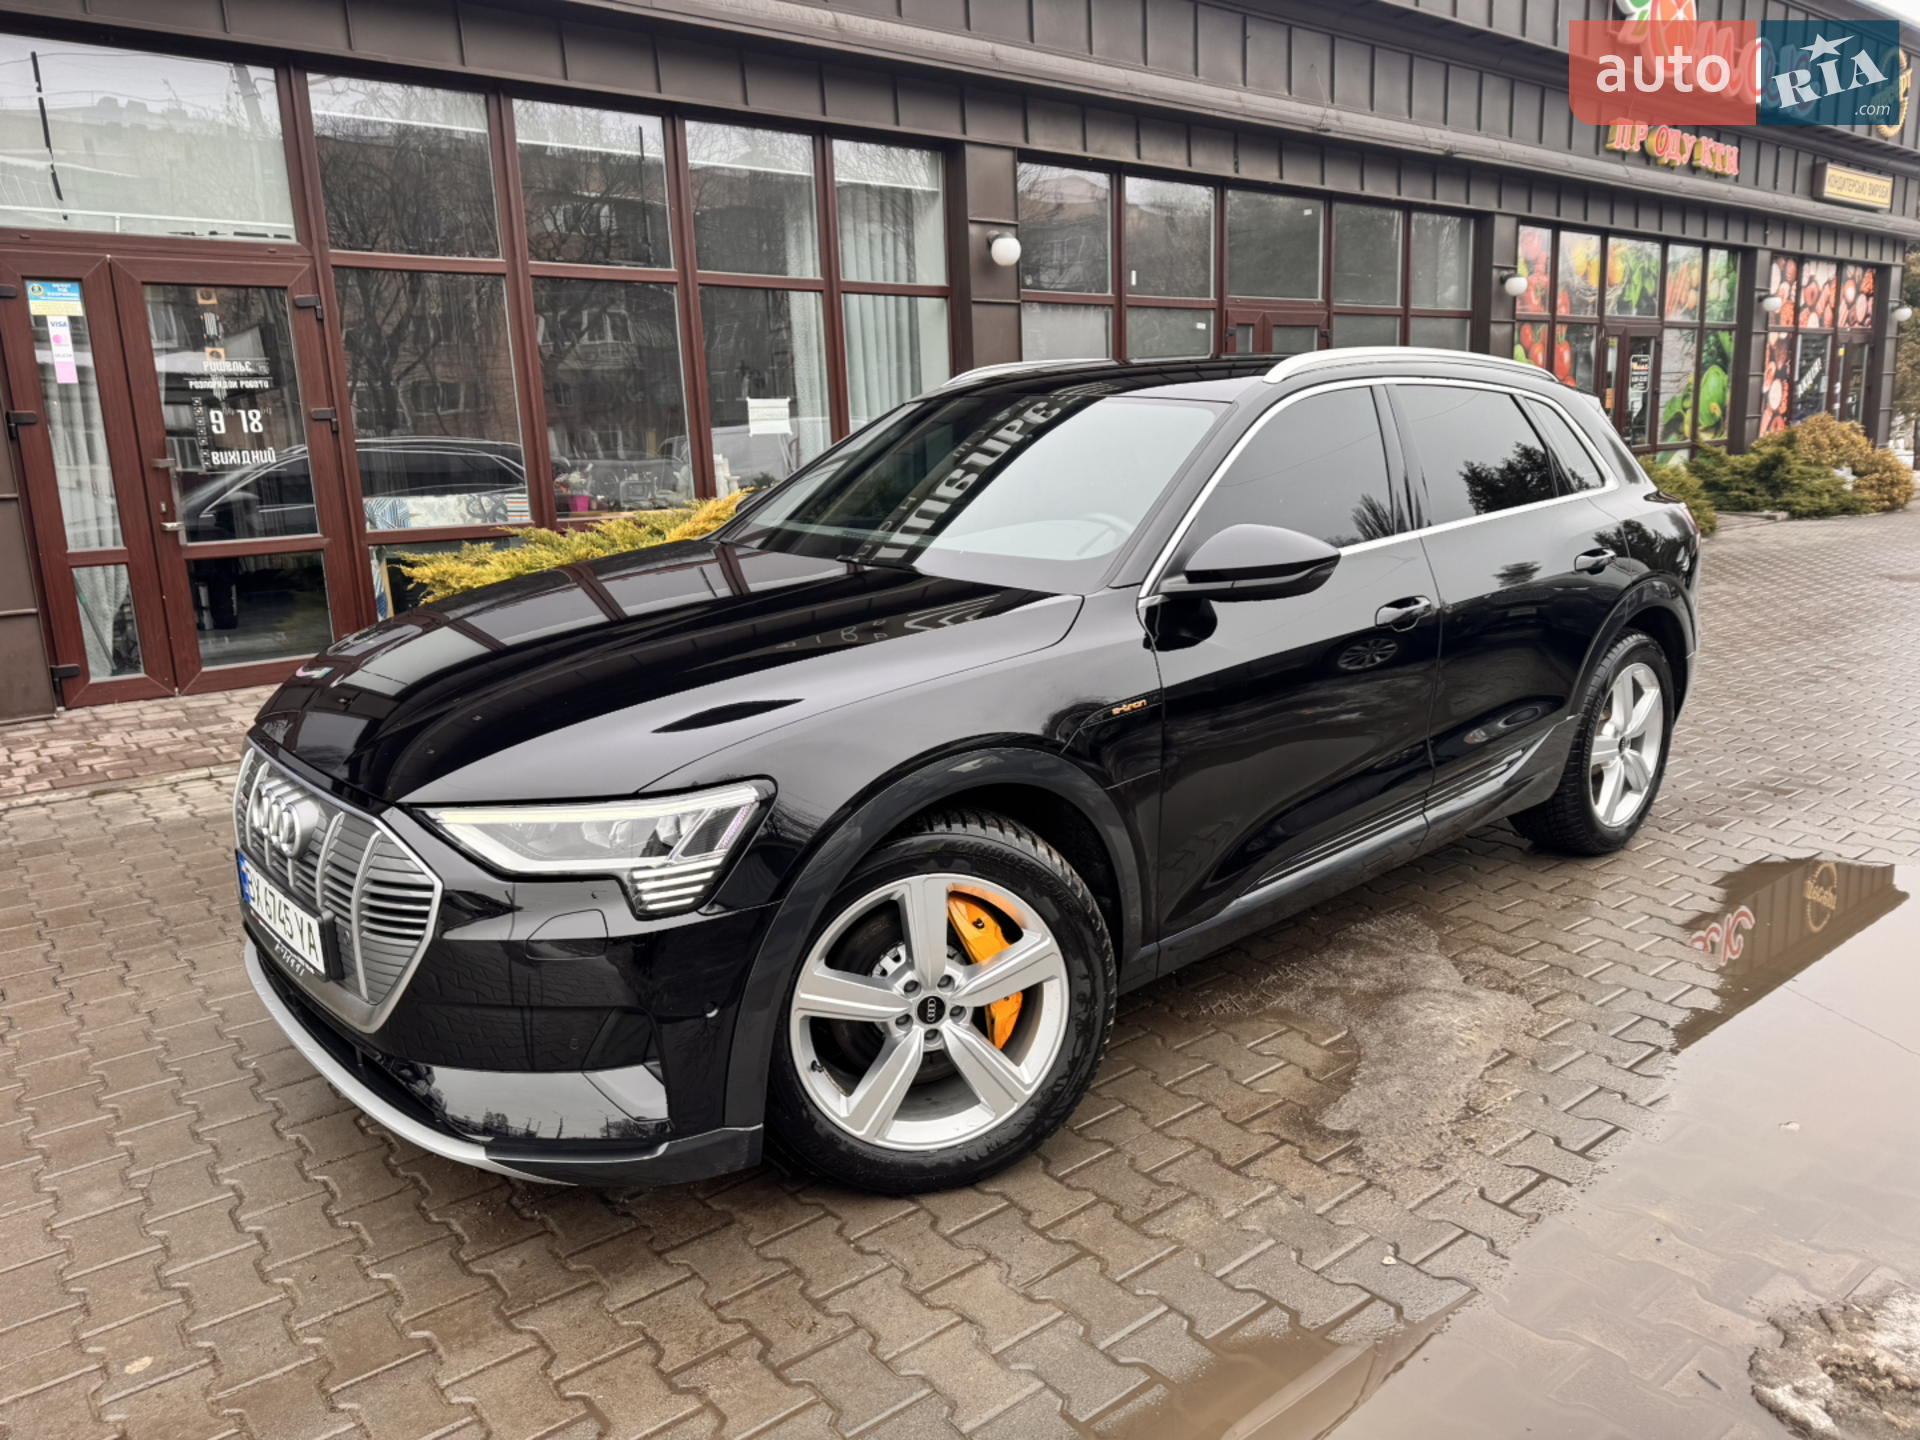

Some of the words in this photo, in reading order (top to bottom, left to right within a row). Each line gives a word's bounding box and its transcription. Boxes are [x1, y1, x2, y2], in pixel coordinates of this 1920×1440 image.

[1609, 118, 1739, 176] ПРОДУКТИ
[50, 320, 68, 328] VISA
[237, 409, 264, 434] 18
[211, 446, 276, 466] ВИХІДНИЙ
[264, 886, 294, 940] 6745
[294, 911, 320, 962] YA
